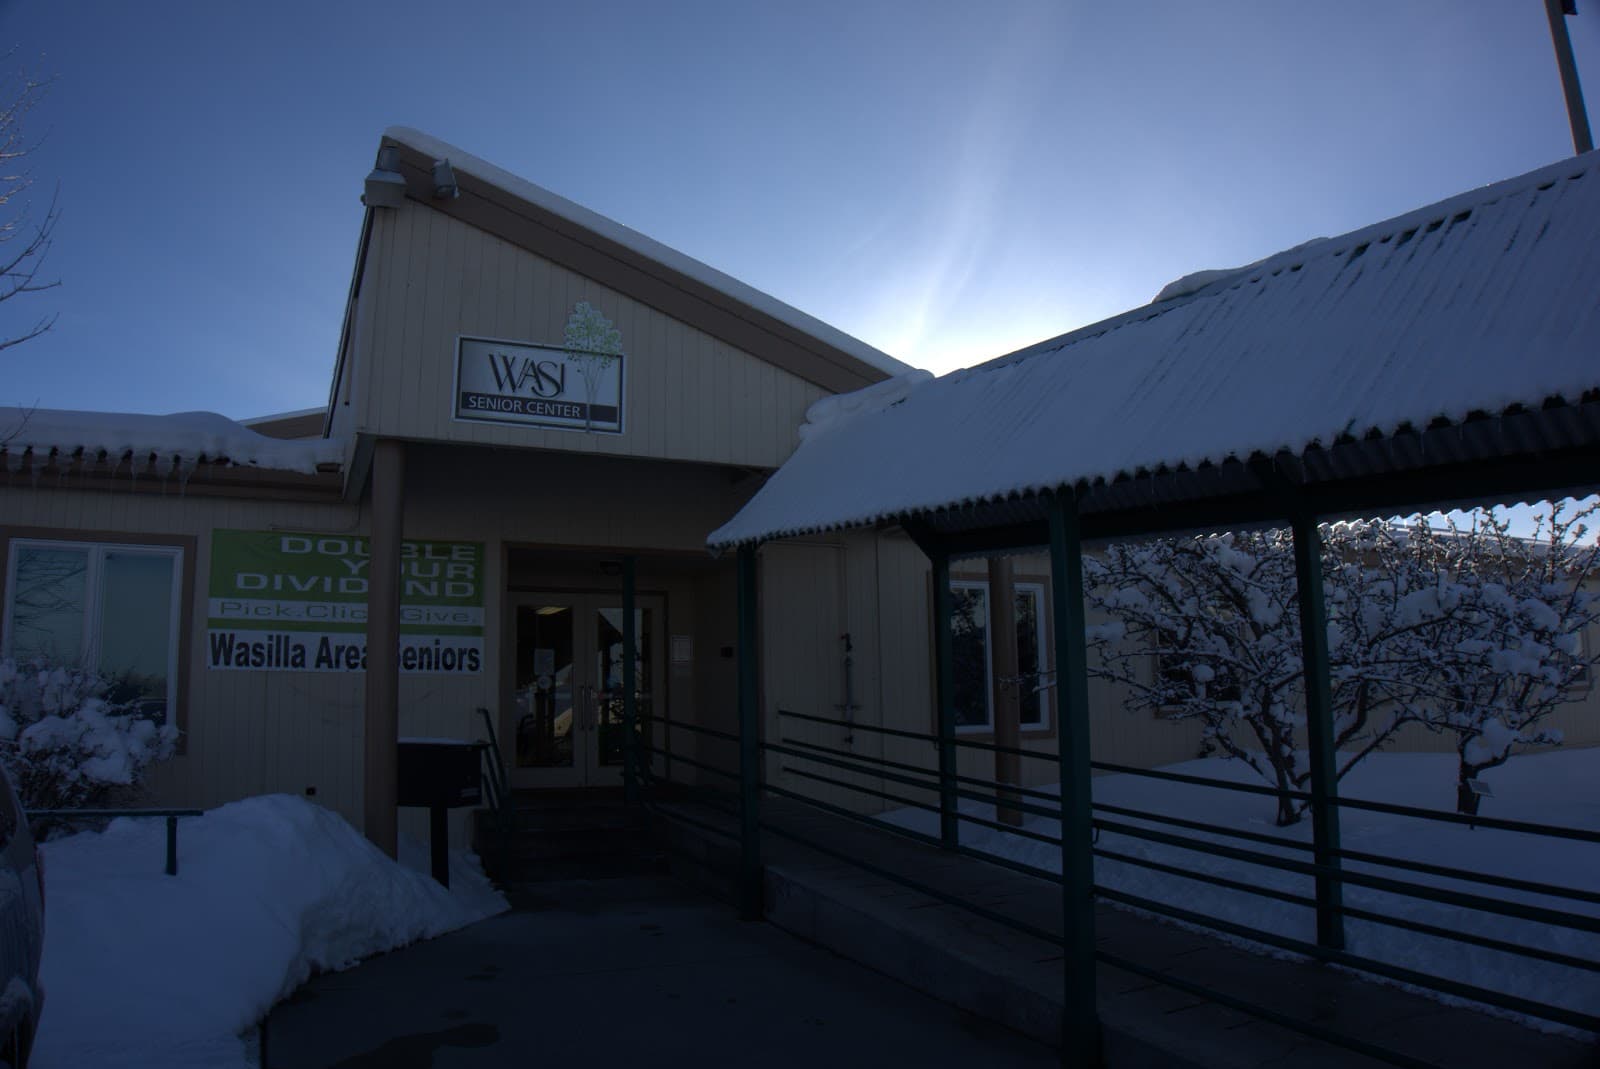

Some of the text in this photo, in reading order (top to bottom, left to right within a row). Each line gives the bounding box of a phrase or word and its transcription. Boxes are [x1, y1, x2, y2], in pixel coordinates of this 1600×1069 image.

[489, 354, 565, 398] WASI
[468, 395, 581, 418] SENIOR CENTER
[340, 558, 476, 579] YUR
[235, 572, 475, 598] DIVIDND
[210, 632, 306, 669] Wasilla
[397, 638, 481, 671] eniors
